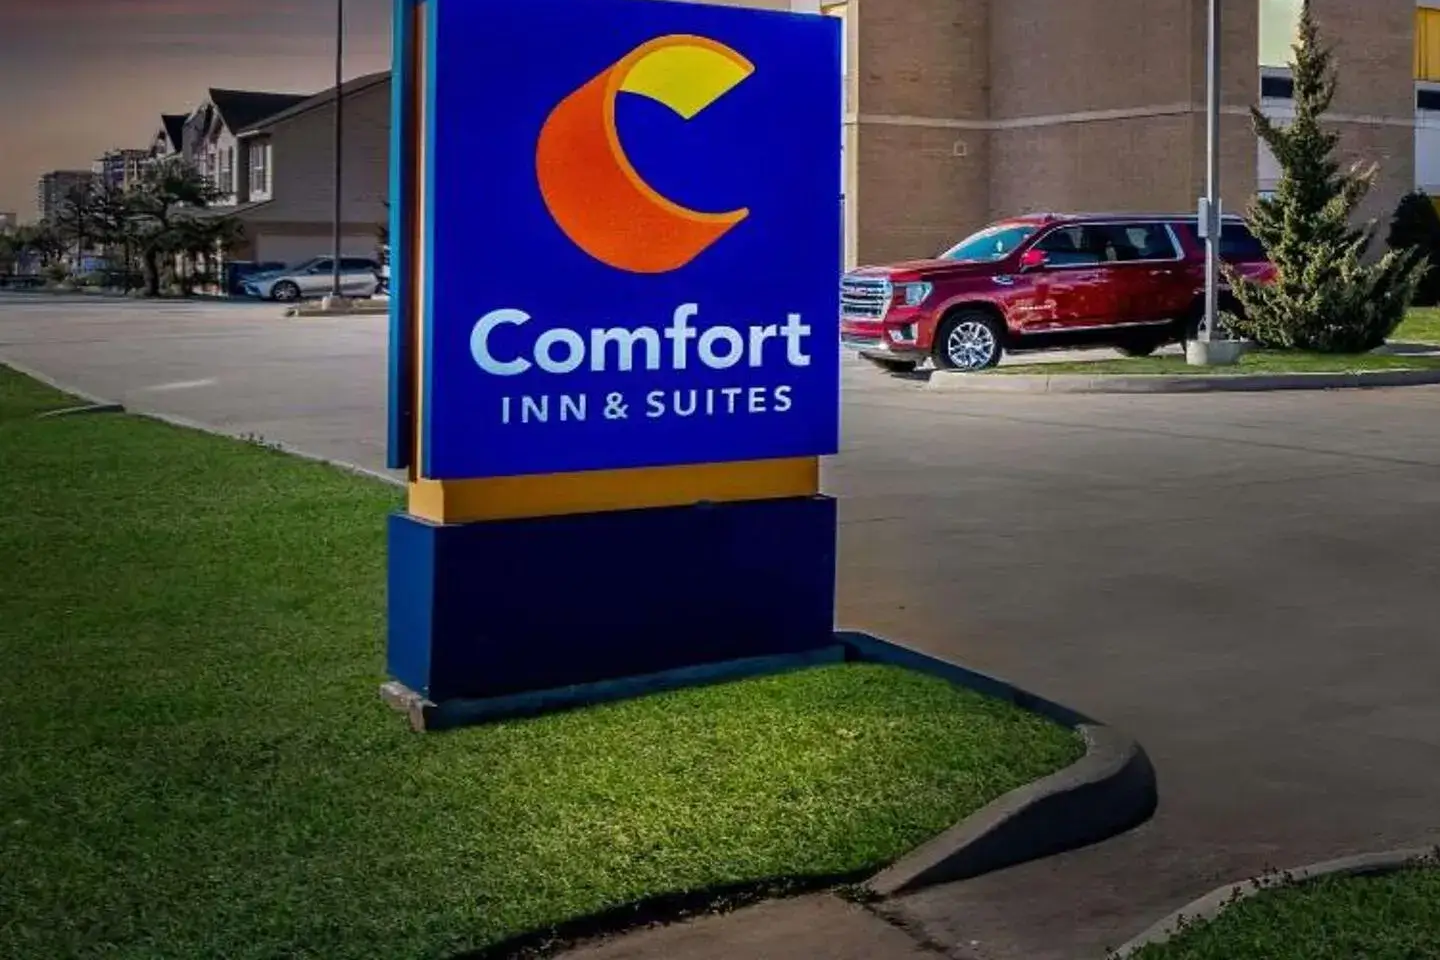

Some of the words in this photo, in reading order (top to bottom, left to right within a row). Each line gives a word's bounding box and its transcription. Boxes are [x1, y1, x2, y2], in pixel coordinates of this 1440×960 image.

[469, 302, 812, 377] Comfort
[502, 393, 587, 424] INN
[603, 391, 629, 420] &
[646, 384, 793, 418] SUITES
